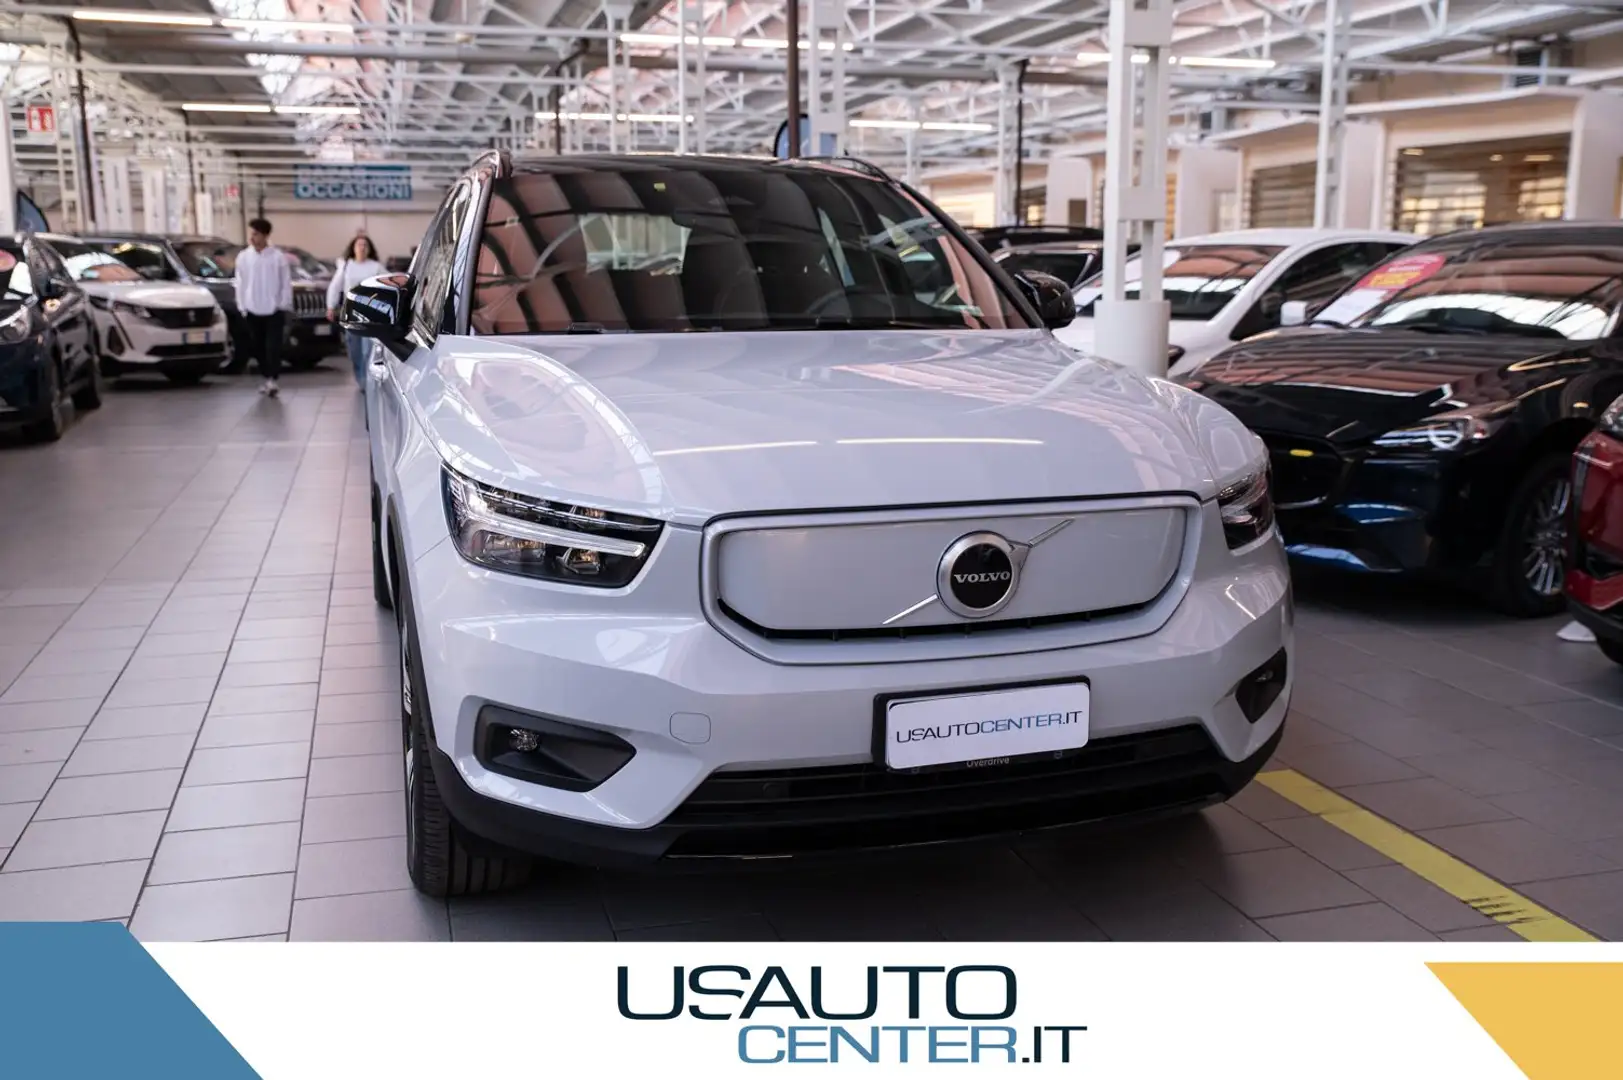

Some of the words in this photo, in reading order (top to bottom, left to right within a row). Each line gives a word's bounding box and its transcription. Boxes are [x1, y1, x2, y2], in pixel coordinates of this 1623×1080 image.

[298, 183, 410, 198] OCCASIONI
[954, 571, 1011, 583] VOLVO
[896, 711, 1082, 743] USAUTOCENTER.IT
[966, 757, 1010, 768] Overdrive
